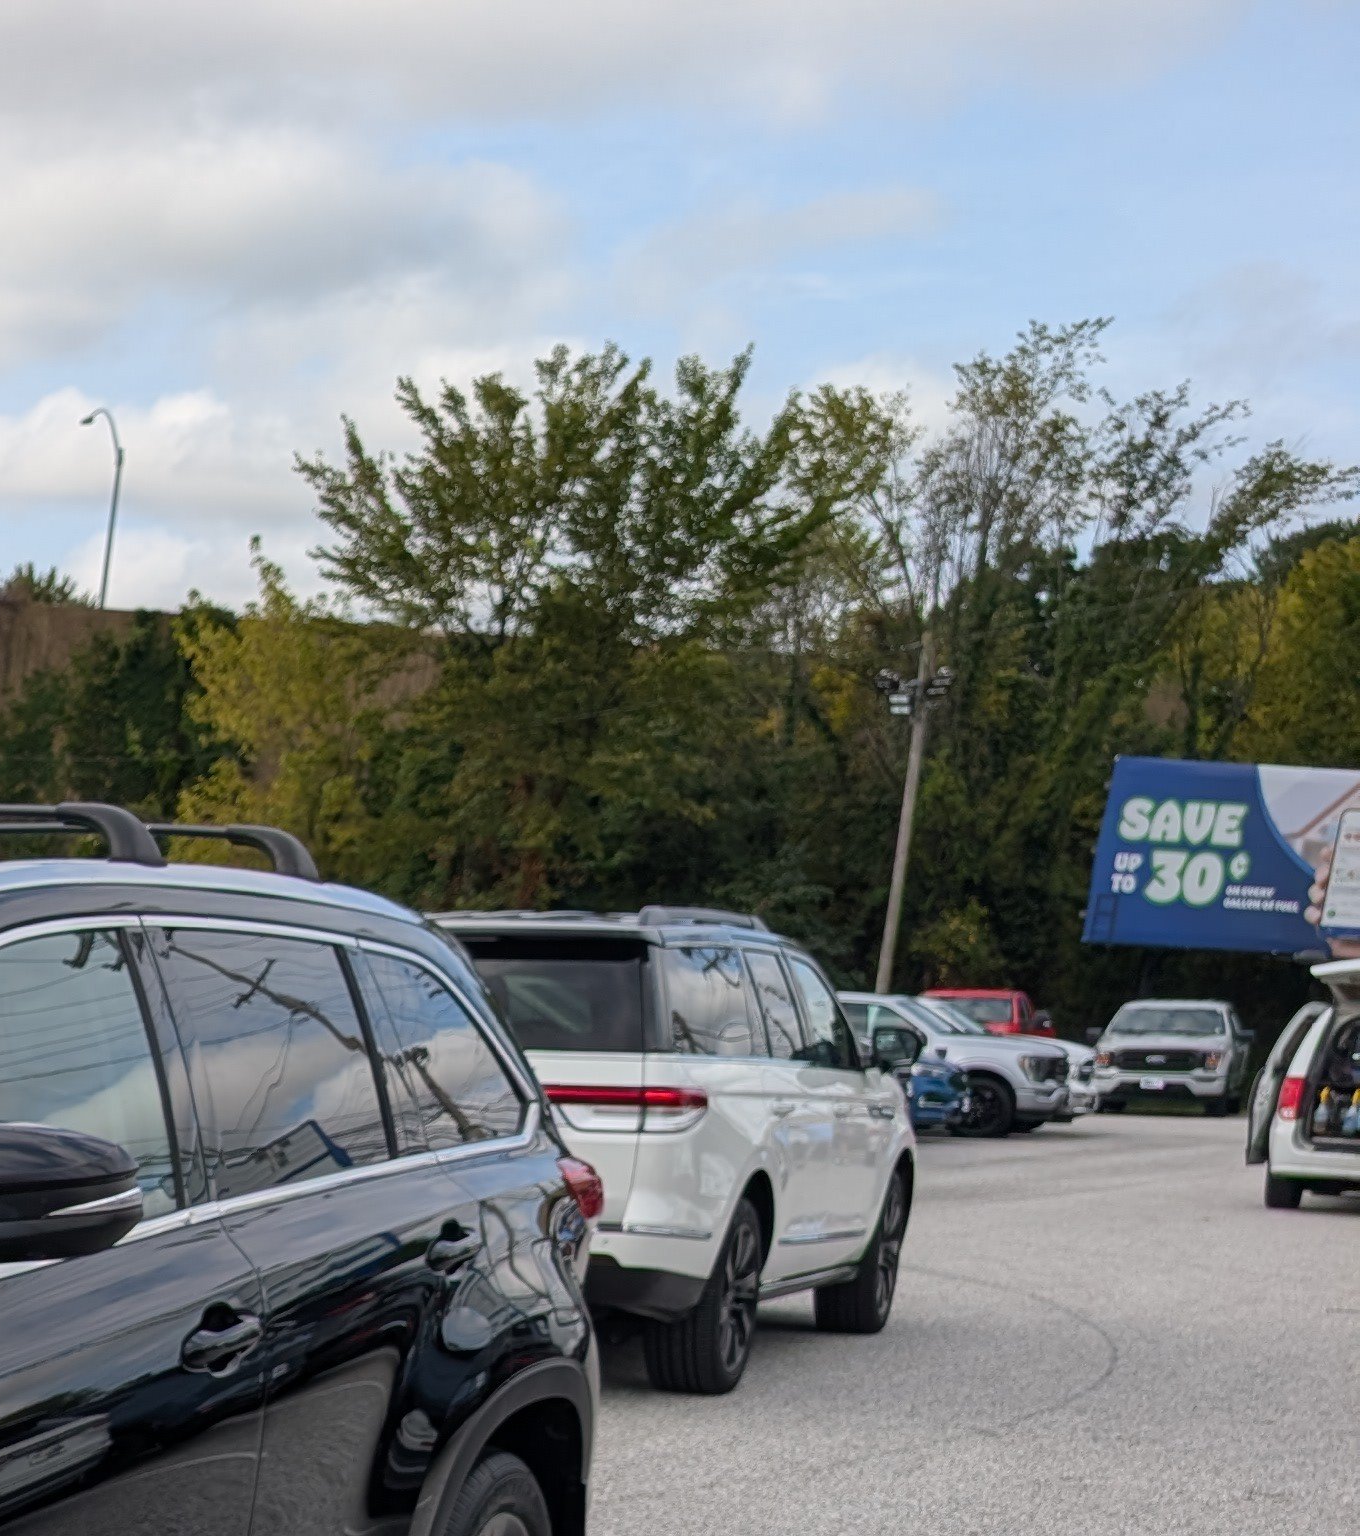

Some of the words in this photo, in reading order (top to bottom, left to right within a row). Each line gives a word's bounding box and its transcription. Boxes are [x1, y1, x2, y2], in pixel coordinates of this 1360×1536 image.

[1118, 796, 1248, 847] SAVE
[1113, 852, 1144, 873] UP
[1111, 873, 1137, 894] TO
